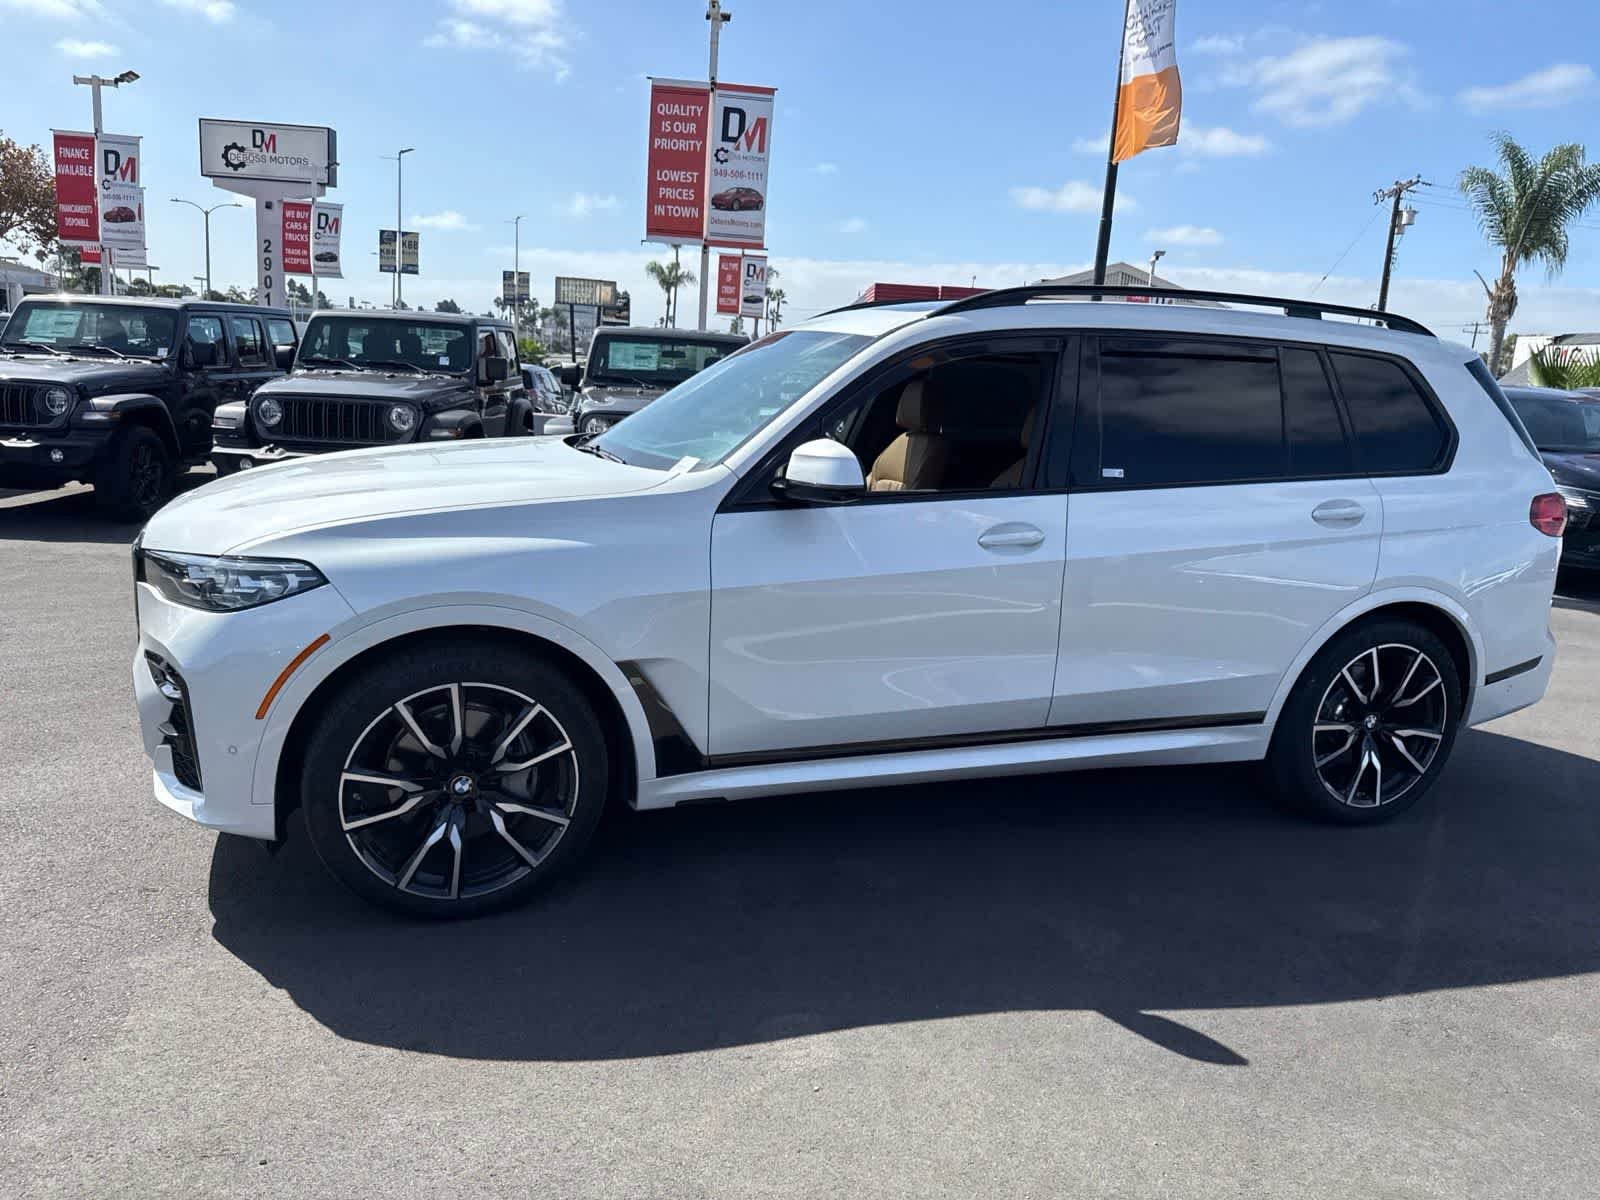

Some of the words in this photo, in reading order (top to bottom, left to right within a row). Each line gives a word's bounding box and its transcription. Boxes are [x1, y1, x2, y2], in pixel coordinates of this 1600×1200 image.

[657, 104, 703, 117] QUALITY
[661, 121, 671, 132] IS
[673, 121, 697, 134] OUR
[721, 106, 767, 153] DM
[252, 129, 276, 153] DM
[654, 138, 702, 152] PRIORITY
[59, 147, 89, 160] FINANCE
[229, 152, 267, 163] DEBOSS
[269, 155, 309, 166] MOTORS
[57, 164, 93, 176] AVAILABLE
[103, 149, 136, 182] DM
[656, 170, 699, 183] LOWEST
[713, 168, 764, 181] 949-506-1111
[659, 187, 695, 200] PRICES
[285, 210, 295, 218] WE
[296, 210, 309, 219] BUY
[654, 205, 667, 217] IN
[668, 205, 699, 218] TOWN
[285, 221, 302, 230] CARS
[285, 232, 308, 241] TRUCKS
